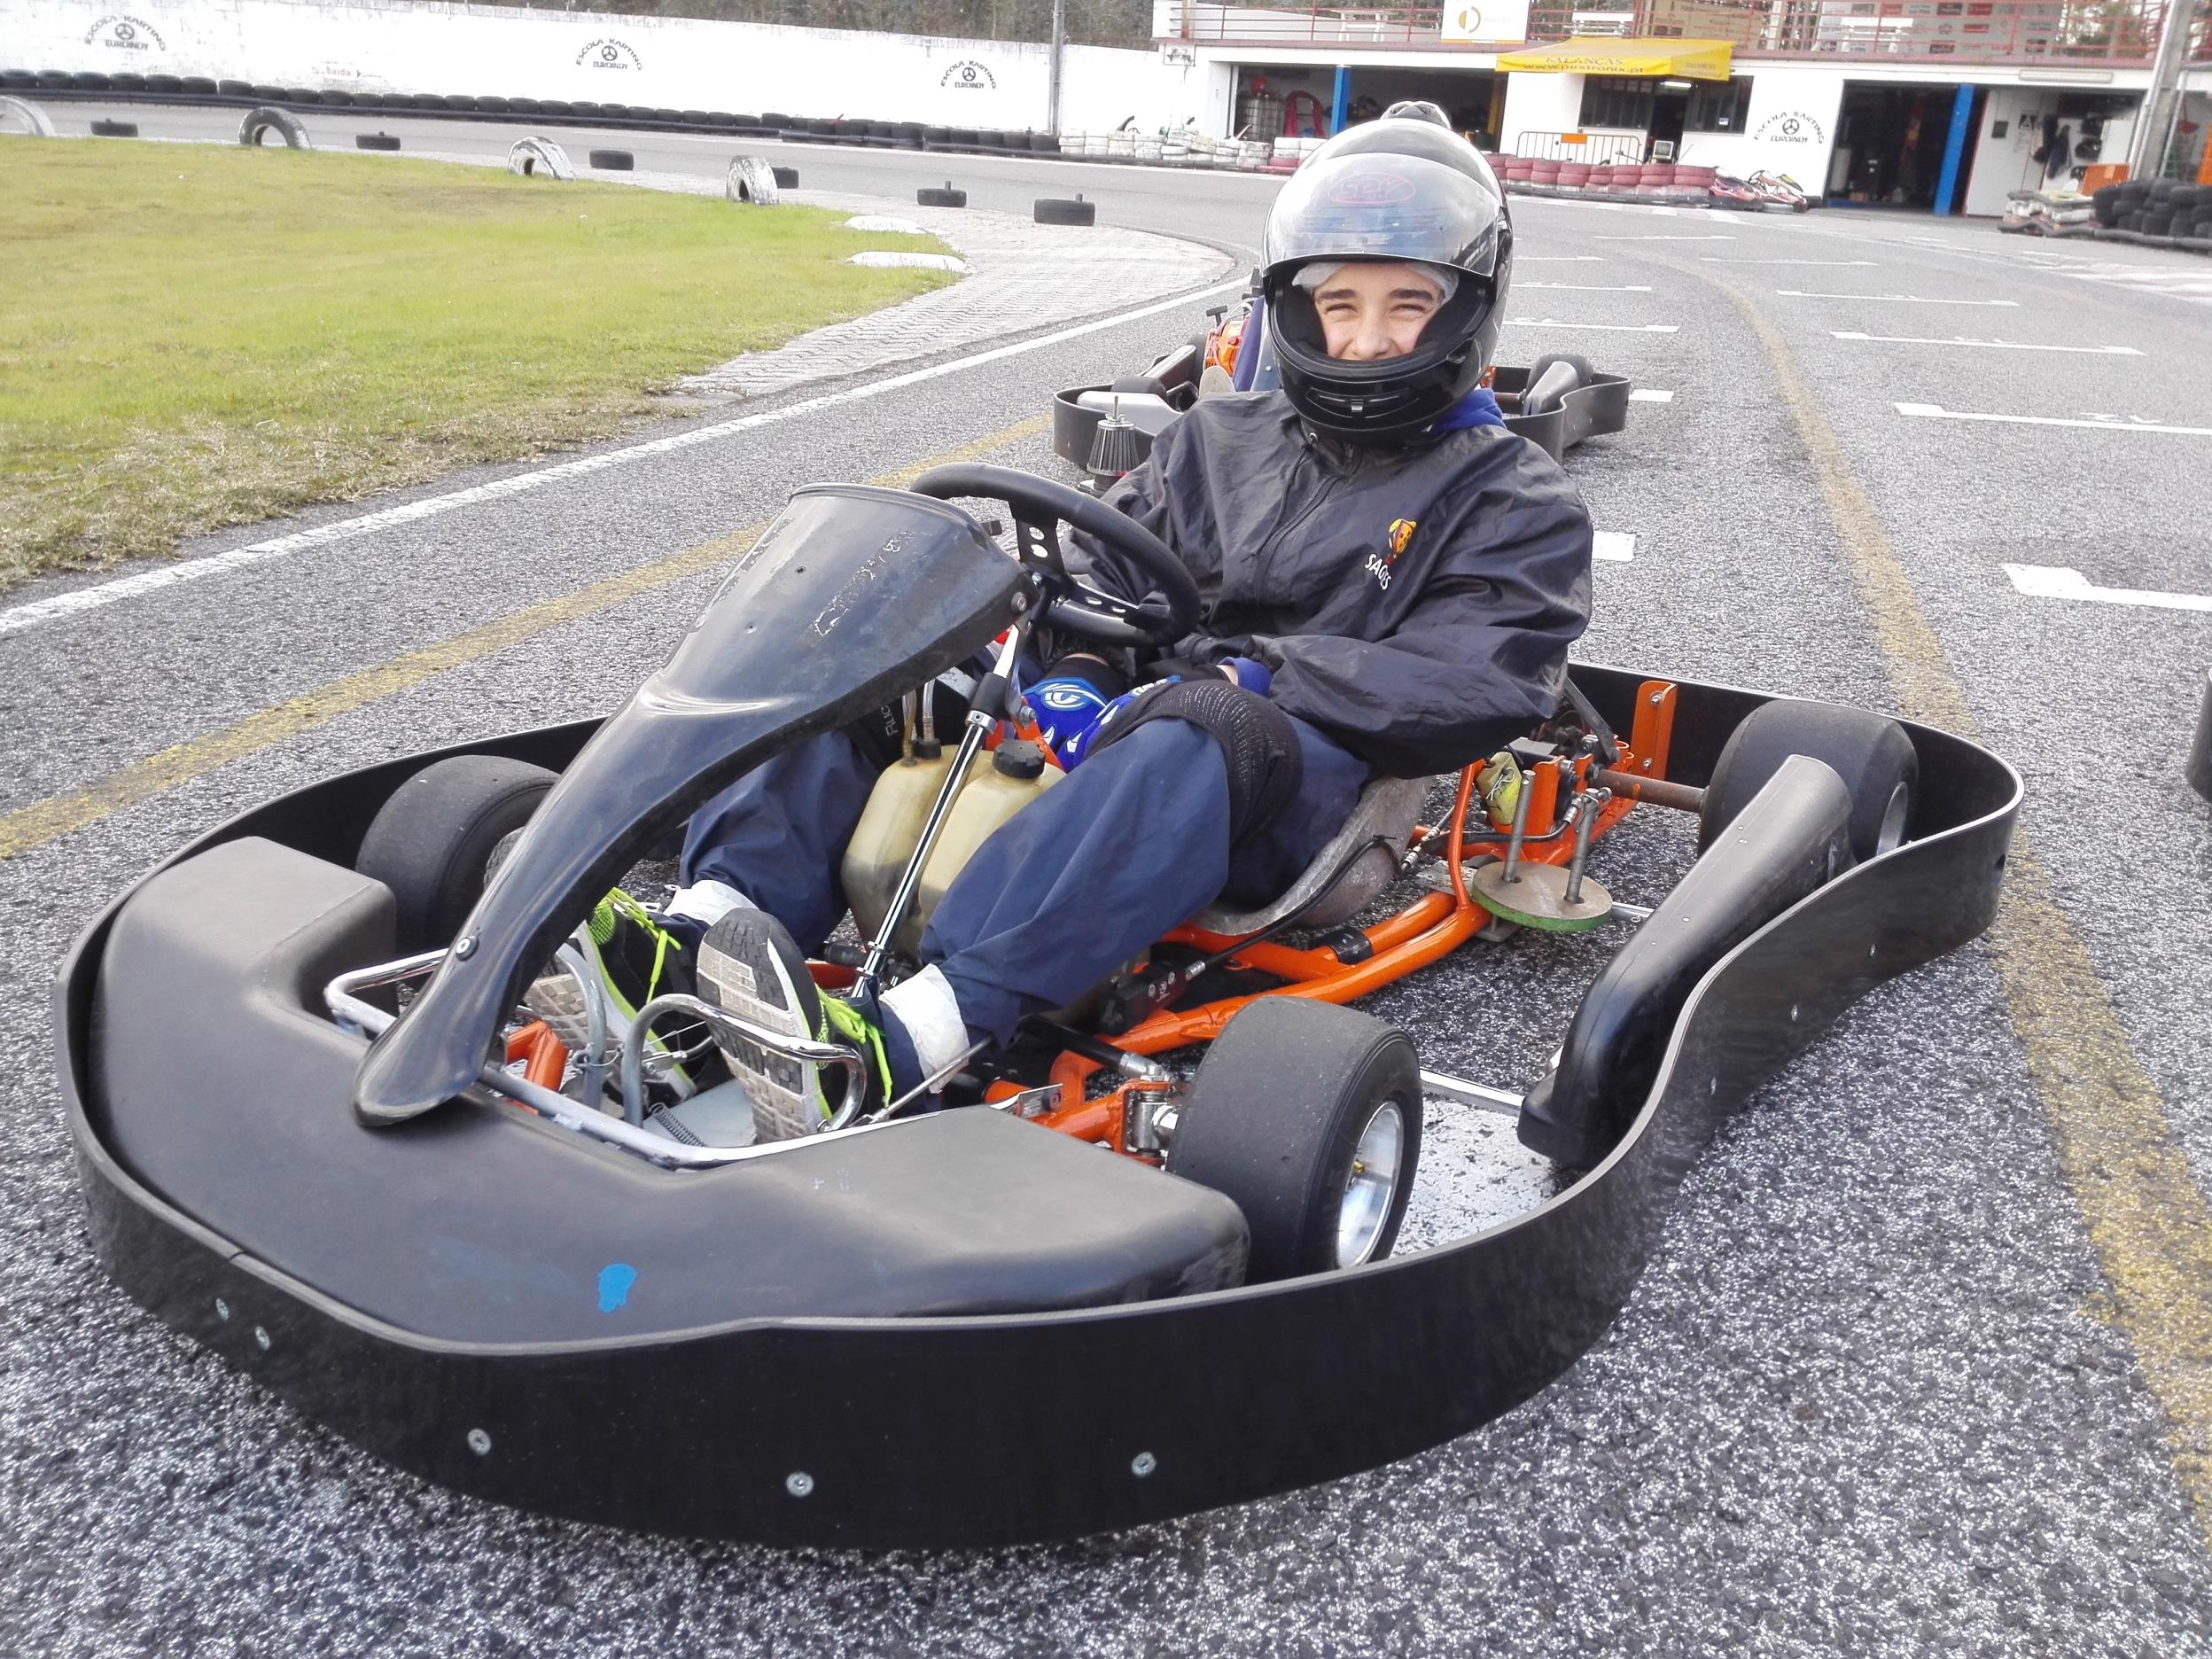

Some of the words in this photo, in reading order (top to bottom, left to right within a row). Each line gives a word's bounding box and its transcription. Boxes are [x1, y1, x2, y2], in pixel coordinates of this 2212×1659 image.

[84, 15, 118, 45] ESCOLA
[123, 15, 167, 51] KARTING
[576, 38, 604, 66] ESCOLA
[609, 38, 643, 71] KARTING
[940, 60, 965, 87] ESCOLA
[969, 59, 997, 90] KARTING
[1793, 111, 1825, 144] KARTING
